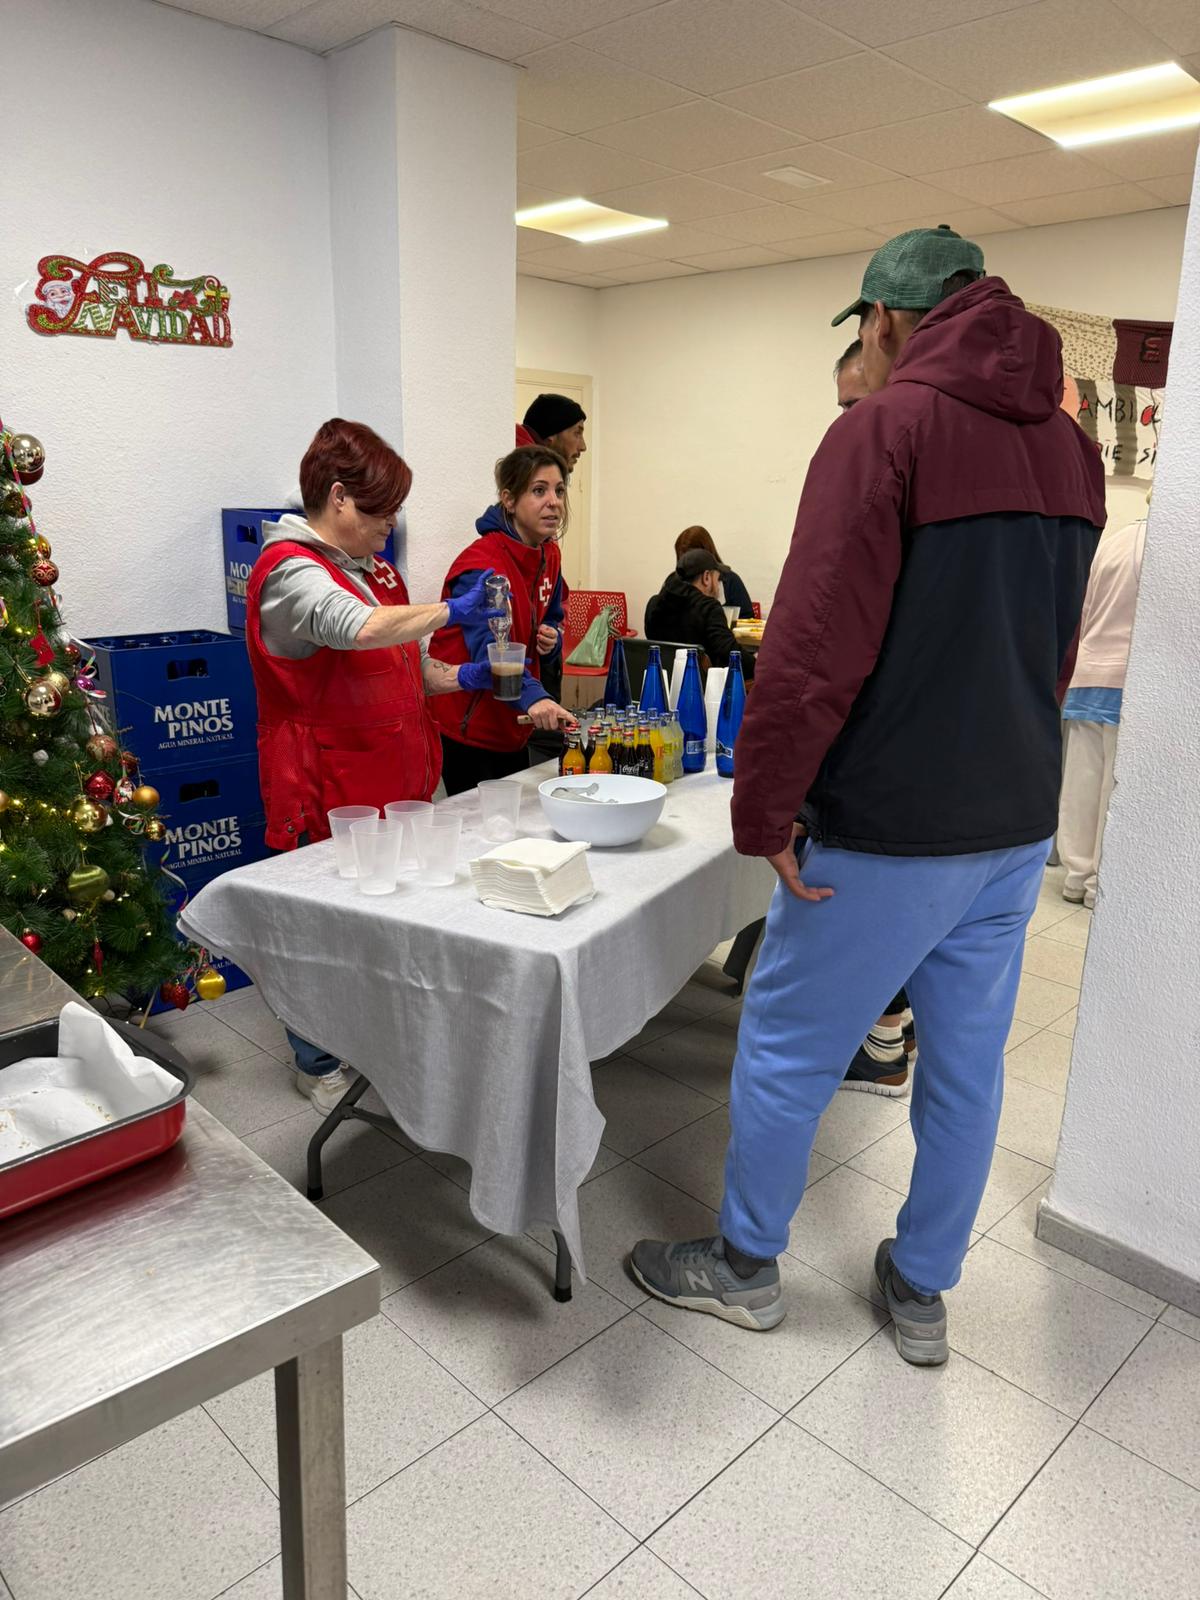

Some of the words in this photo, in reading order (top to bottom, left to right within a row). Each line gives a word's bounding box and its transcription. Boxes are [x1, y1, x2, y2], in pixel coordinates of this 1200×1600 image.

[71, 302, 233, 346] NAVIDAD
[154, 698, 231, 723] MONTE
[168, 714, 234, 739] PINOS
[158, 742, 176, 750] AGUA
[177, 737, 205, 747] MINERAL
[205, 733, 235, 743] NATURAL
[165, 816, 240, 845] MONTE
[178, 831, 242, 859] PINOS
[168, 861, 186, 870] AGUA
[187, 855, 214, 866] MINERAL
[214, 848, 242, 860] NATURAL
[685, 1270, 713, 1292] N
